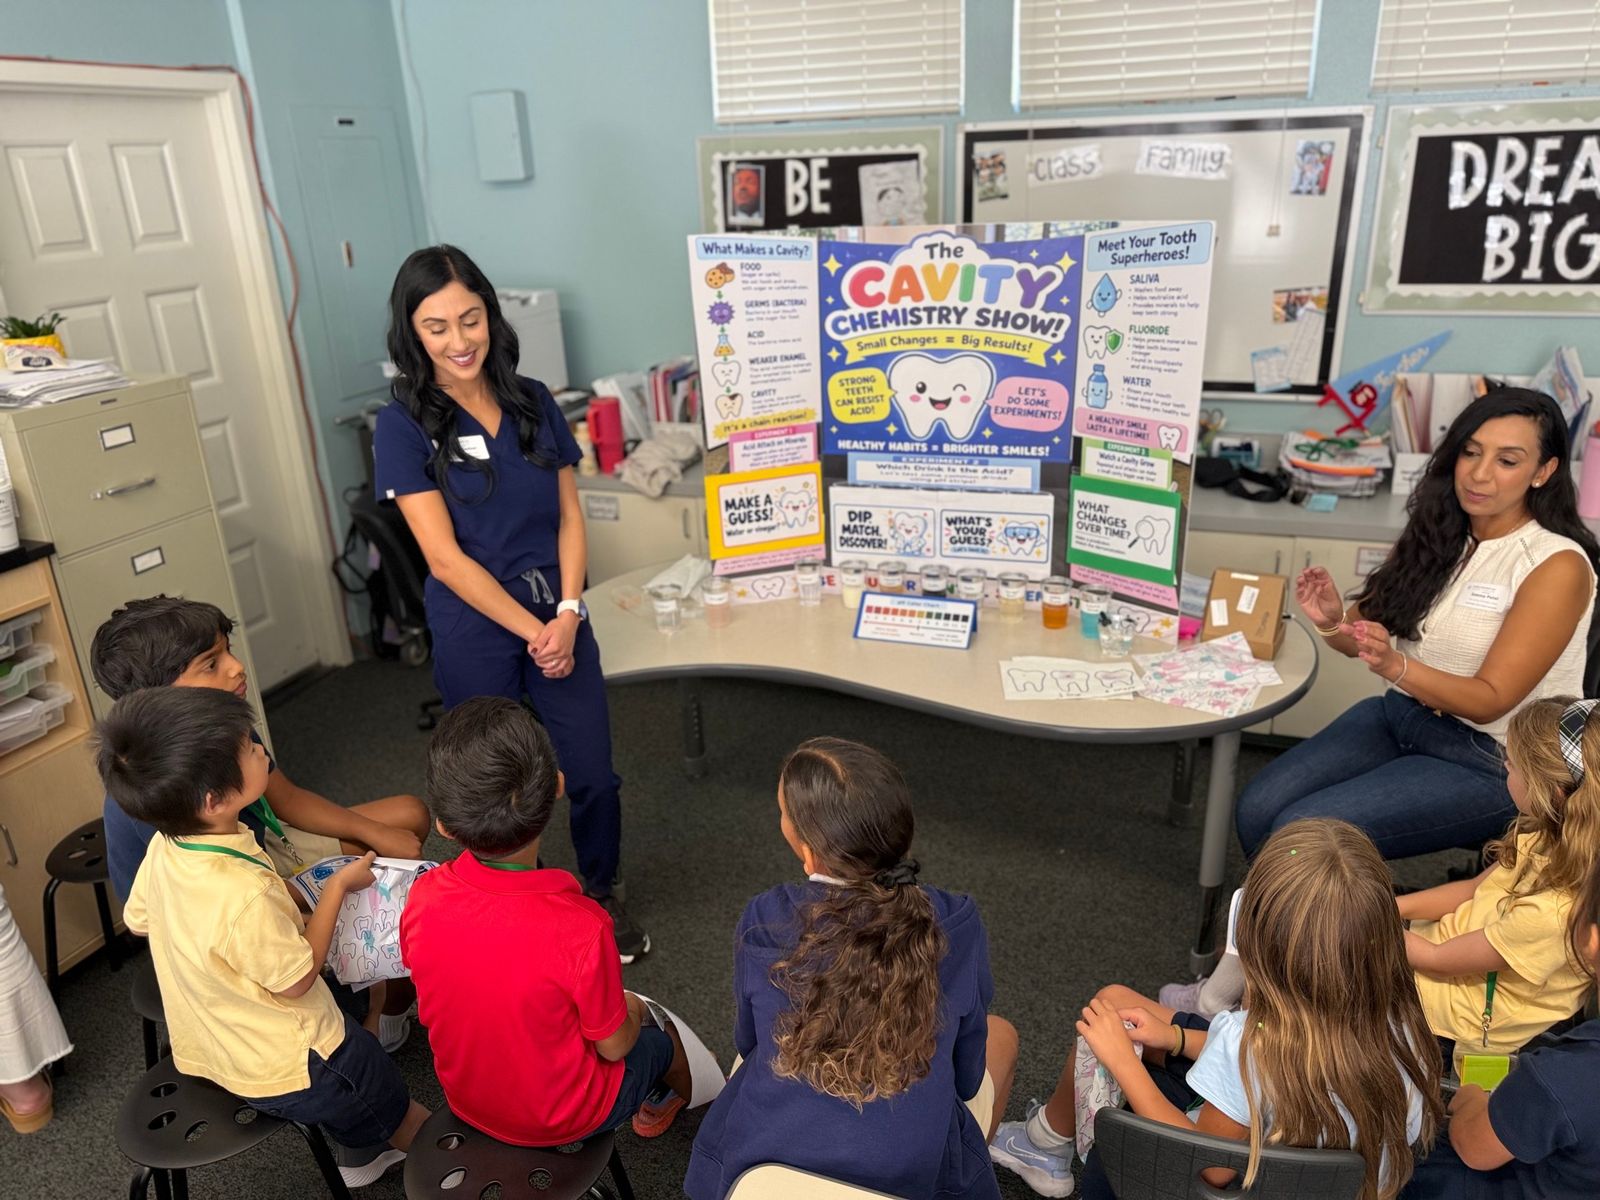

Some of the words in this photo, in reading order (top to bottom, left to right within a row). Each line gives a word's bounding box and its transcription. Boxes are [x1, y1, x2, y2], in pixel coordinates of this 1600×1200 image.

[1146, 145, 1225, 173] Family
[785, 158, 831, 217] BE
[1098, 239, 1126, 253] Meet
[1128, 235, 1156, 249] Your
[1159, 229, 1197, 246] Tooth
[1482, 211, 1600, 282] BIG
[702, 242, 732, 255] What
[735, 243, 766, 255] Makes
[768, 247, 774, 255] a
[776, 245, 809, 258] Cavity?
[924, 241, 964, 260] The
[1110, 246, 1190, 267] Superheroes!
[740, 262, 762, 271] FOOD
[849, 262, 1057, 309] CAVITY
[1129, 273, 1160, 285] SALIVA
[744, 299, 770, 308] GERMS
[772, 298, 808, 307] (BACTERIA)
[831, 305, 969, 336] CHEMISTRY
[974, 307, 1065, 339] SHOW!
[1129, 324, 1170, 336] FLUORIDE
[856, 338, 887, 352] Small
[890, 335, 938, 350] Changes
[961, 335, 980, 348] Big
[984, 337, 1033, 353] Results!
[749, 354, 778, 365] WEAKER
[780, 352, 807, 362] ENAMEL
[838, 375, 877, 386] STRONG
[1122, 375, 1152, 388] WATER
[751, 388, 776, 398] CAVITY
[845, 386, 874, 396] TEETH
[1017, 386, 1047, 398] LET'S
[835, 398, 854, 407] CAN
[856, 394, 885, 405] RESIST
[1008, 396, 1022, 406] DO
[1024, 397, 1051, 408] SOME
[850, 406, 876, 416] ACID!
[994, 406, 1063, 421] EXPERIMENTS!
[724, 422, 738, 432] It's
[750, 417, 770, 428] chain
[773, 412, 807, 424] reaction!
[1094, 415, 1126, 426] HEALTHY
[1126, 420, 1148, 431] SMILE
[1086, 423, 1108, 432] LASTS
[1109, 426, 1114, 434] A
[1114, 427, 1150, 440] LIFETIME!
[743, 442, 756, 450] Acid
[757, 440, 775, 448] Attack
[837, 439, 886, 452] HEALTHY
[888, 441, 928, 453] HABITS
[942, 442, 999, 456] BRIGHTER
[1002, 444, 1050, 457] SMILES!
[1107, 442, 1140, 454] EXPERIMENT
[901, 456, 969, 466] EXPERIMENT
[1098, 452, 1116, 461] Watch
[1122, 456, 1138, 466] Cavity
[1140, 458, 1155, 468] Grow
[914, 465, 944, 473] Drink
[981, 468, 1015, 476] Acid?
[724, 496, 760, 512] MAKE
[764, 493, 772, 506] A
[1077, 499, 1110, 514] WHAT
[728, 508, 774, 526] GUESS!
[848, 510, 872, 524] DIP.
[945, 516, 992, 528] WHAT'S
[1076, 510, 1127, 529] CHANGES
[726, 528, 744, 538] Water
[755, 522, 780, 536] vinegar?
[842, 524, 882, 537] MATCH.
[954, 526, 987, 536] YOUR
[1076, 521, 1102, 534] OVER
[1104, 527, 1131, 541] TIME?
[840, 536, 888, 550] DISCOVER!
[949, 536, 992, 548] GUESS?
